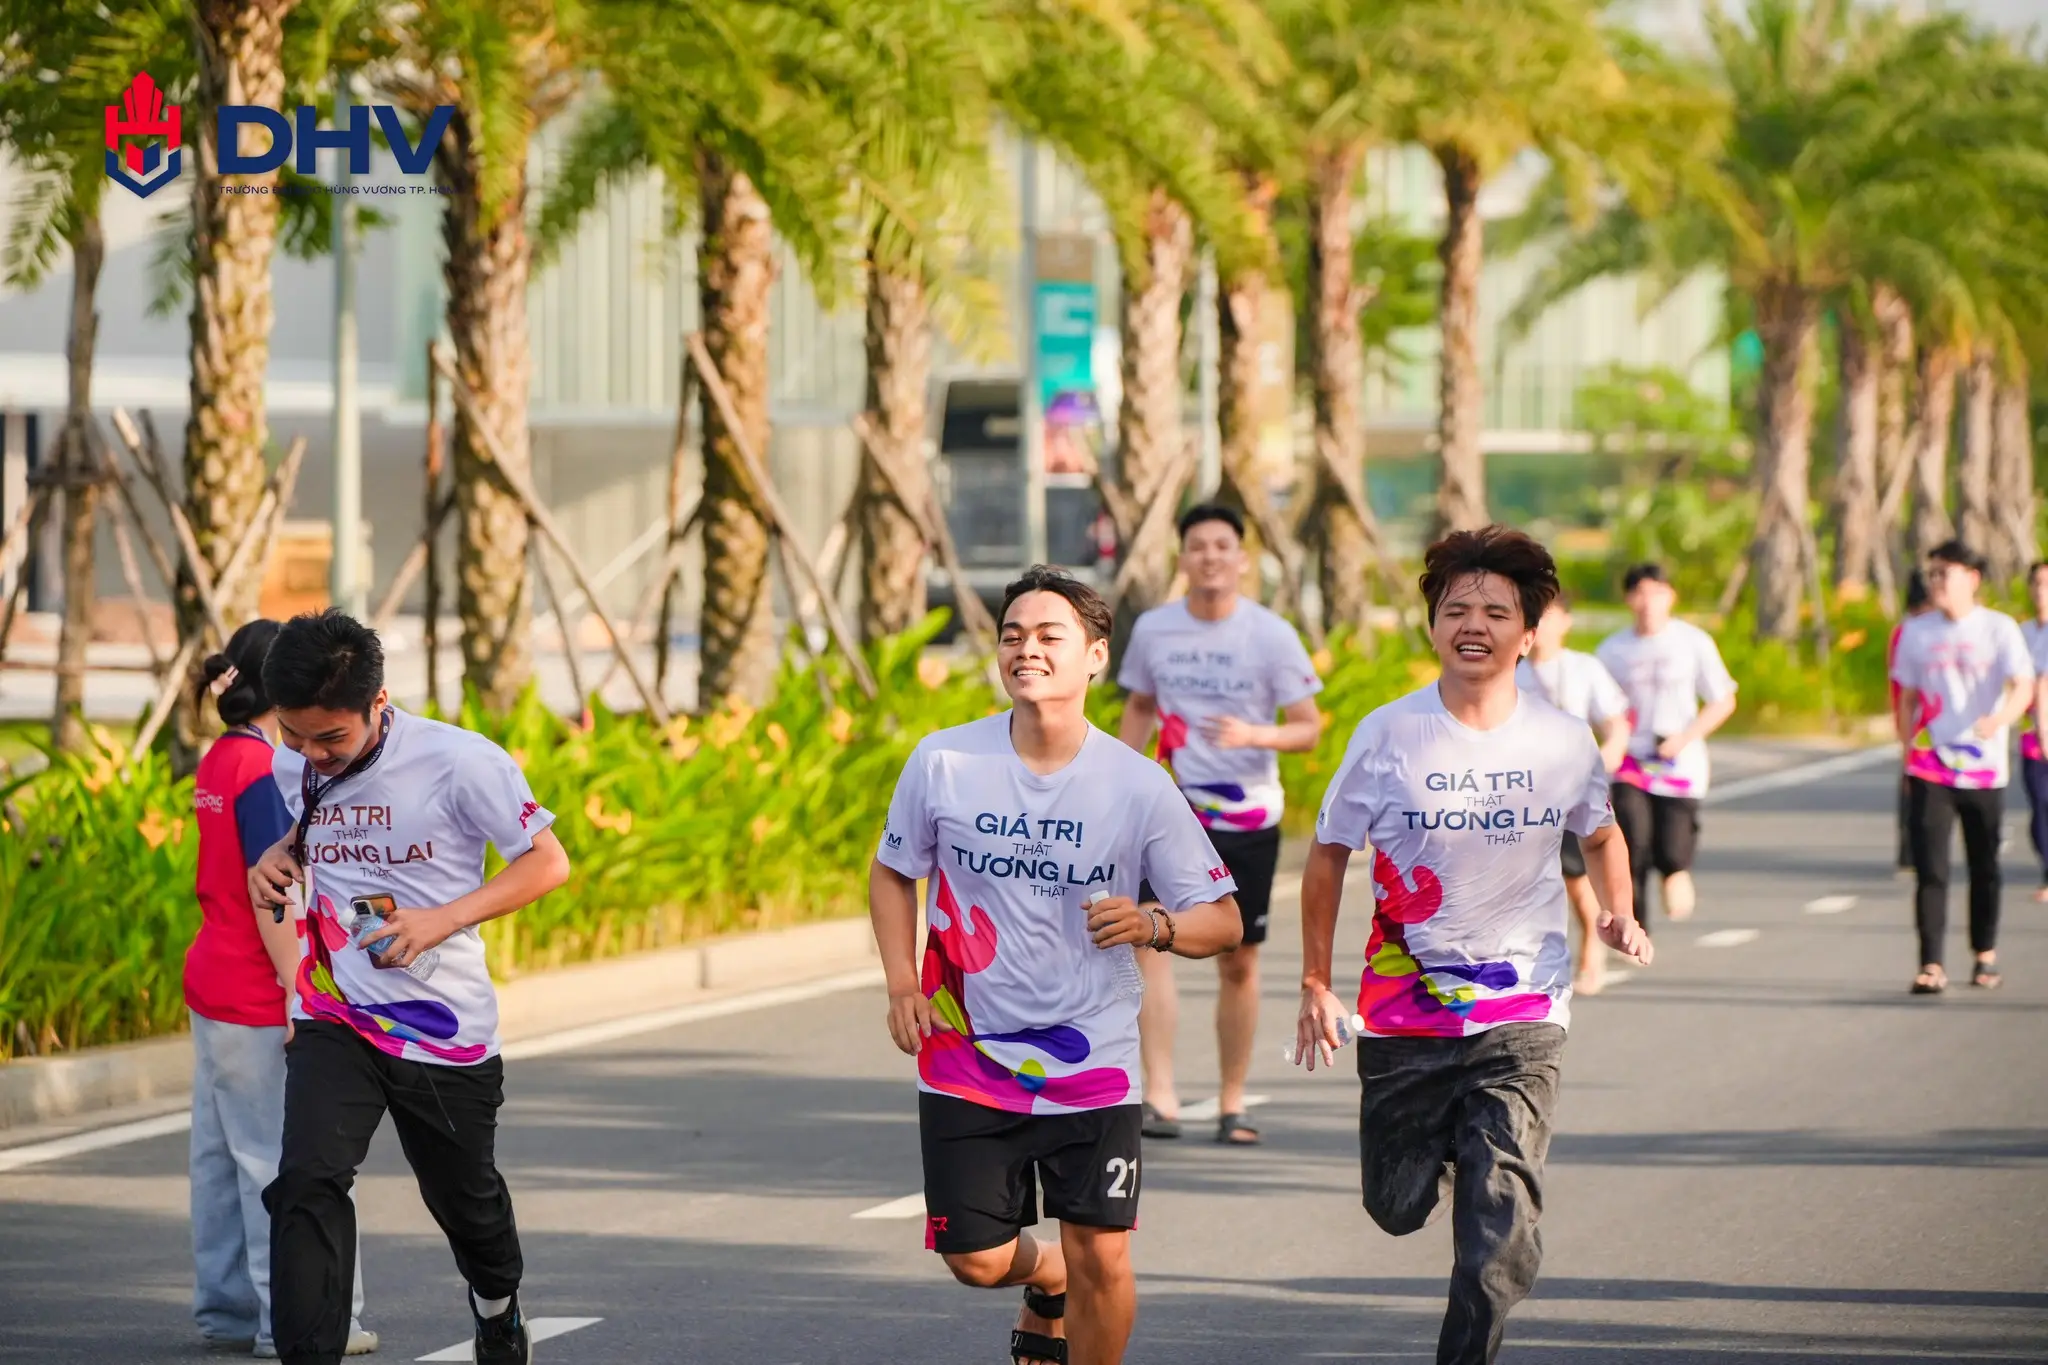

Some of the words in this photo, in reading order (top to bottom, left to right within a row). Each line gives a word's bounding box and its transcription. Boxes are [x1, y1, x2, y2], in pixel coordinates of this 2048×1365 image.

[1425, 768, 1480, 793] GIÁ
[1484, 769, 1533, 793] TRỊ
[1463, 793, 1505, 809] THẬT
[308, 804, 346, 826] GIÁ
[350, 805, 392, 831] TRỊ
[1402, 808, 1515, 831] TƯƠNG
[1523, 807, 1561, 828] LAI
[333, 827, 369, 842] THẬT
[975, 812, 1031, 840] GIÁ
[1037, 819, 1083, 849] TRỊ
[1484, 830, 1525, 846] THẬT
[304, 842, 380, 865] ƯƠNG
[385, 841, 433, 865] LAI
[1012, 841, 1053, 857] THẬT
[359, 866, 393, 880] THẬT
[951, 844, 1059, 882] TƯƠNG
[1066, 863, 1115, 886] LAI
[1029, 884, 1069, 900] THẬT
[1106, 1157, 1137, 1198] 21
